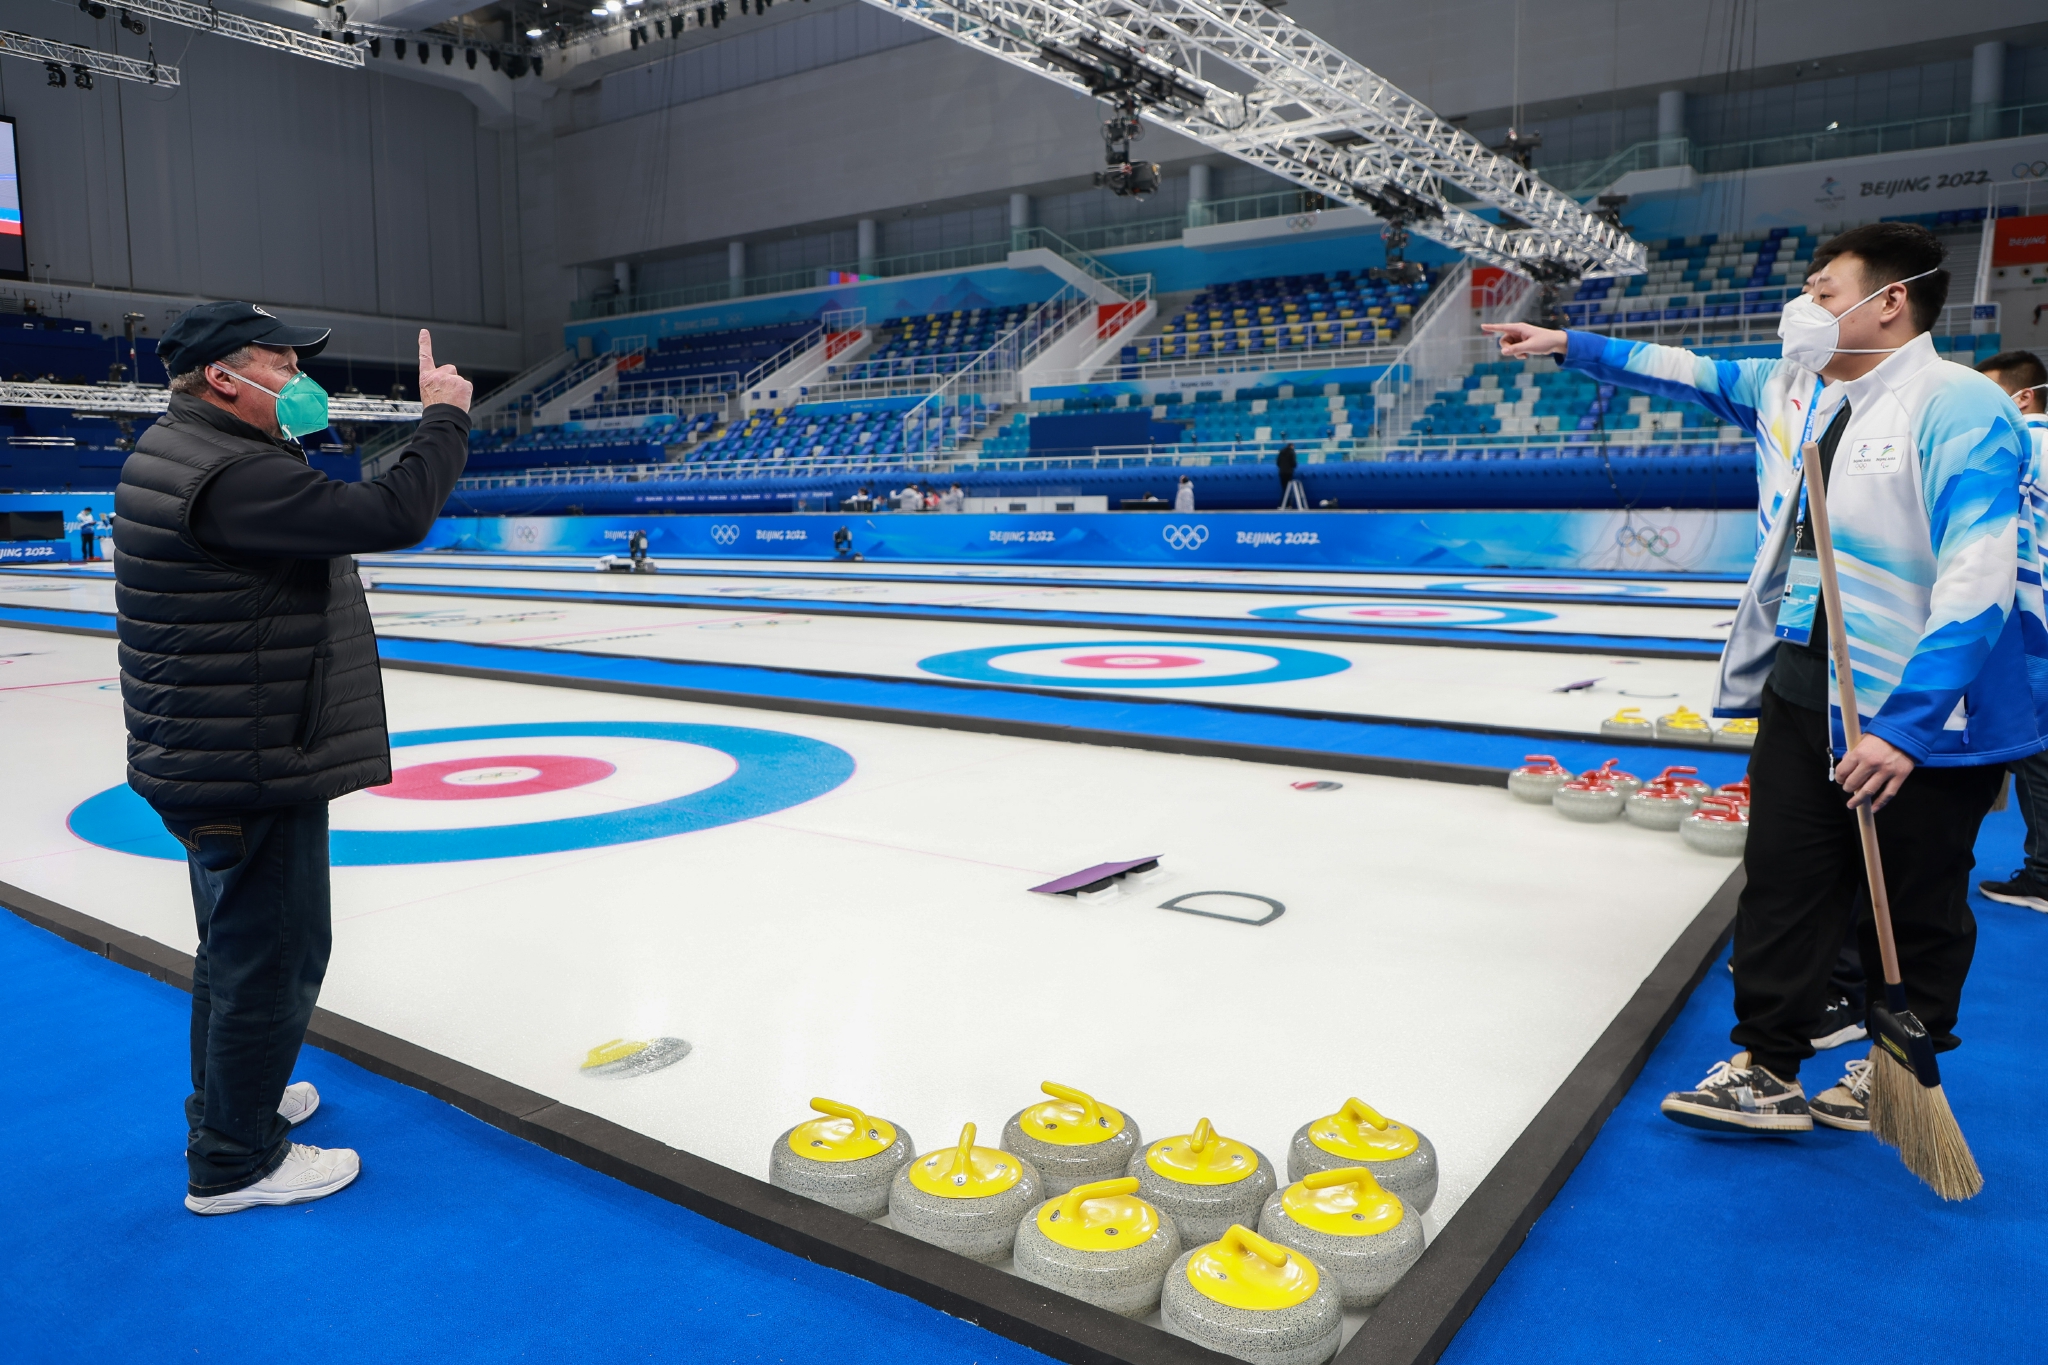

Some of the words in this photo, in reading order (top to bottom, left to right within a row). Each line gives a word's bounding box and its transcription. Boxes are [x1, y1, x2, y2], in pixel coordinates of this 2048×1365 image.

[1860, 176, 1931, 199] BEIJING
[1936, 170, 1992, 189] 2022
[2008, 235, 2047, 248] BEIJING
[989, 530, 1025, 544] BEIJING
[1027, 530, 1056, 542] 2022
[1236, 531, 1282, 548] BEIJING
[1284, 532, 1321, 545] 2022
[24, 546, 56, 557] 2022
[1783, 628, 1789, 637] 2
[1156, 890, 1287, 927] D
